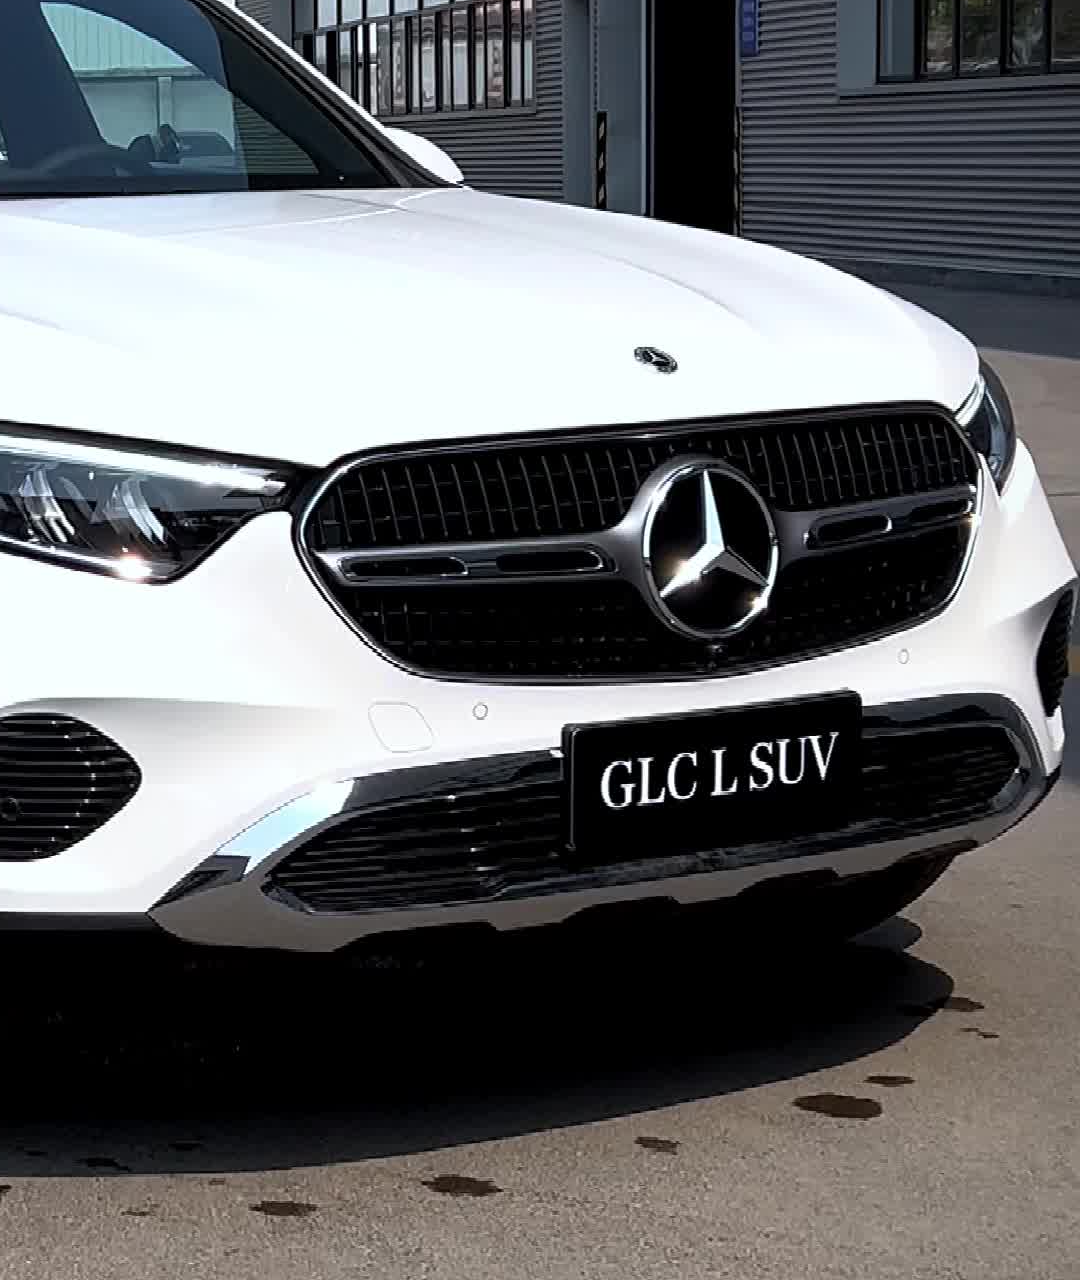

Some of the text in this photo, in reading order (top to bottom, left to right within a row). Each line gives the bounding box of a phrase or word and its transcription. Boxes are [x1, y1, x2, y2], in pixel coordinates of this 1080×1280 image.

[600, 731, 839, 808] GLC L SUV
